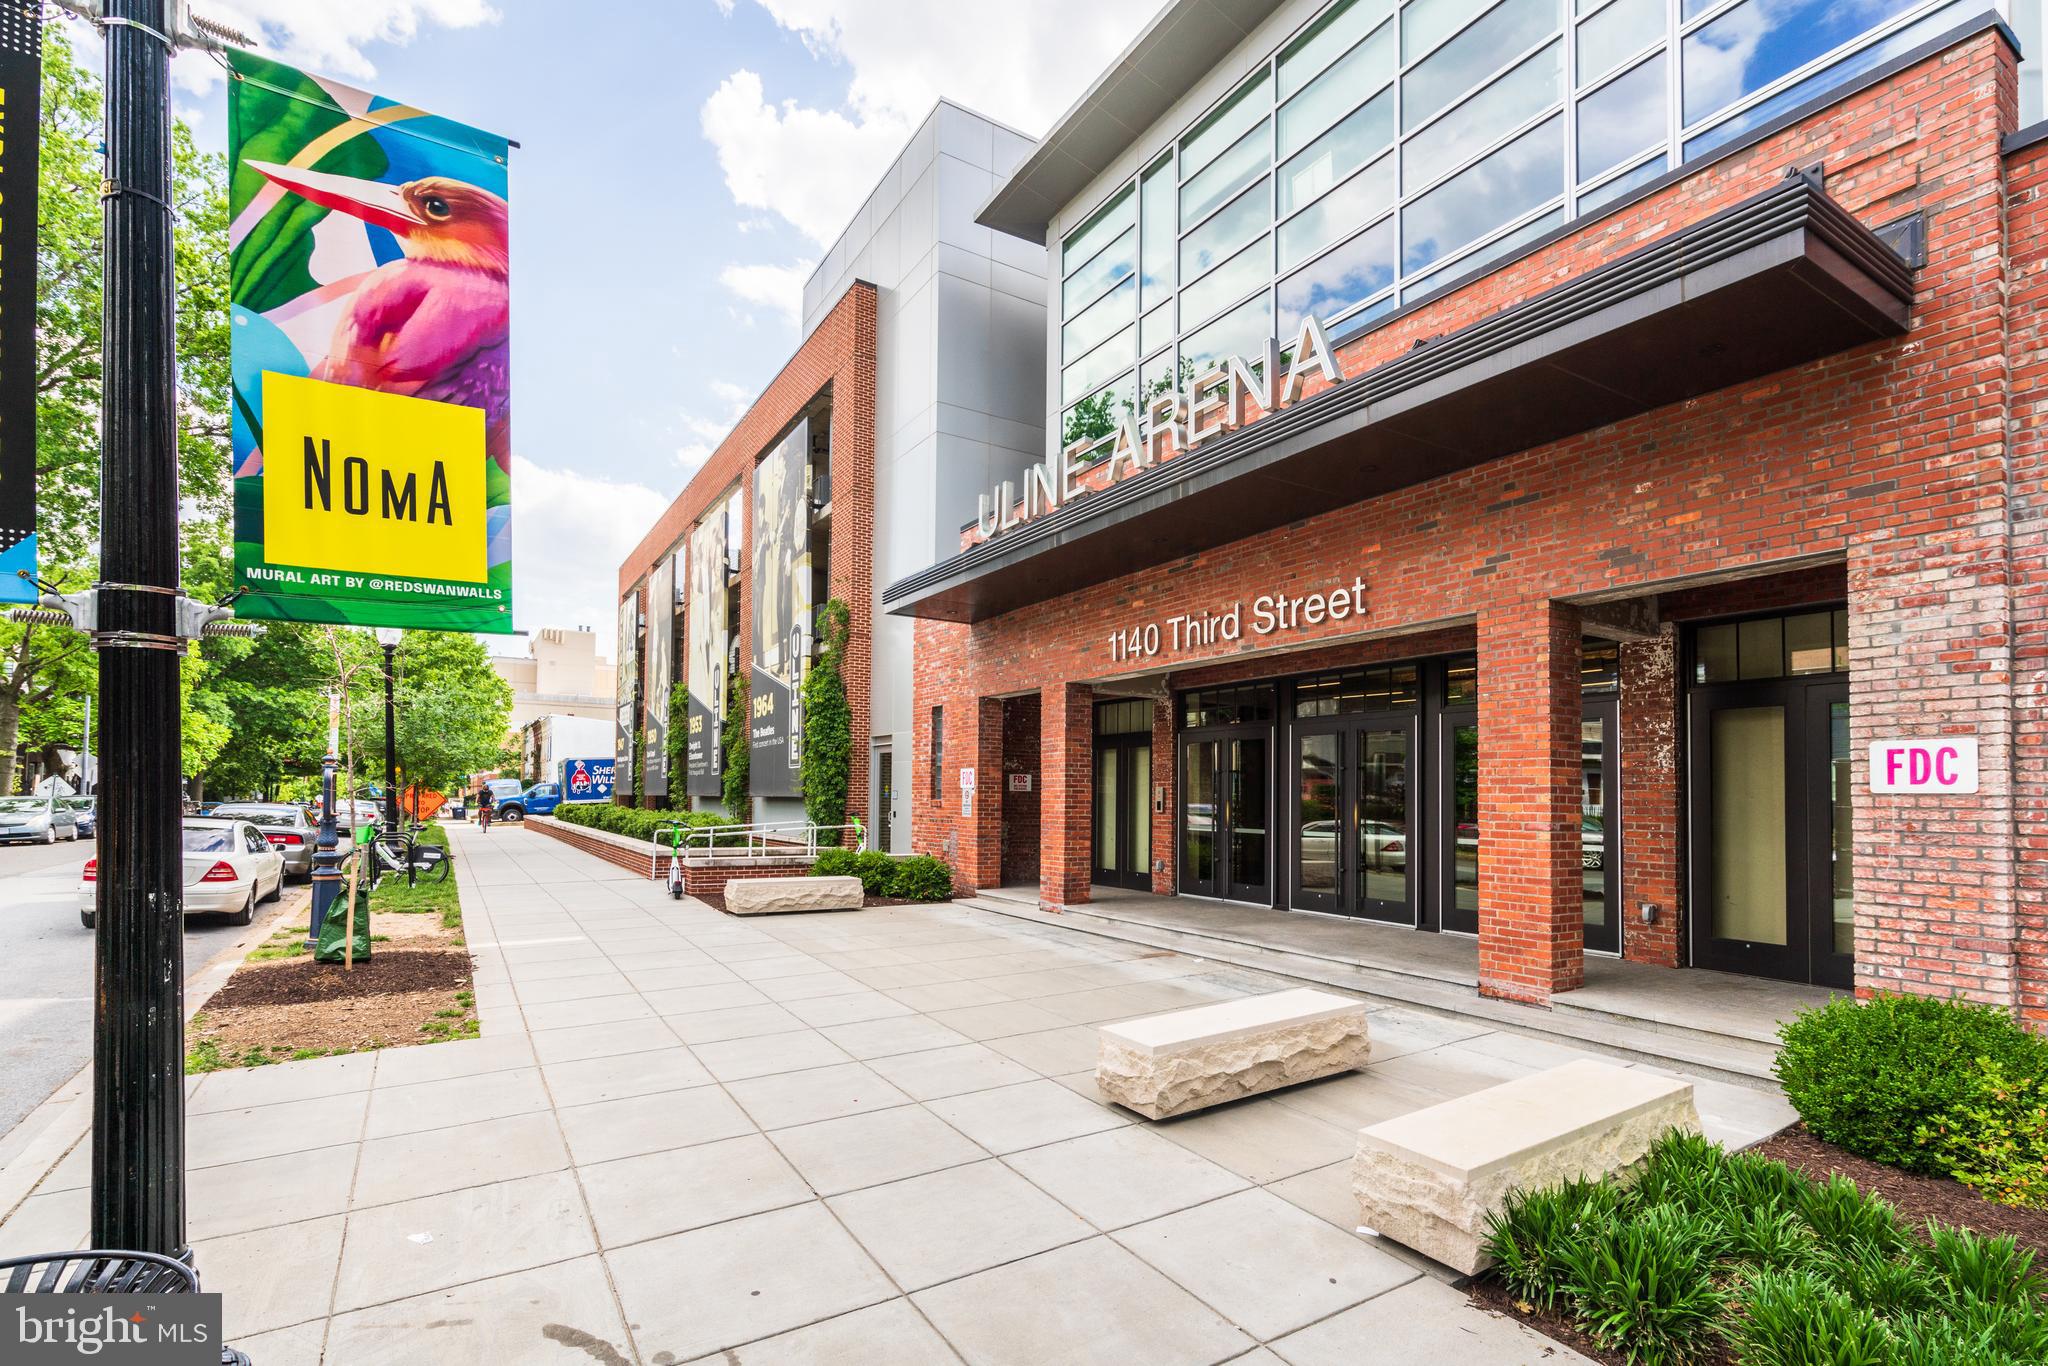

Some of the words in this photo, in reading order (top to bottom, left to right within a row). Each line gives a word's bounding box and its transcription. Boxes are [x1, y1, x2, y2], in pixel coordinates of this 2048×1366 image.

[976, 435, 1095, 538] ULINE
[1106, 314, 1346, 482] ARENA
[246, 567, 305, 584] MURAL
[310, 575, 341, 587] ART
[345, 577, 364, 588] BY
[369, 578, 502, 600] @REDSWANWALLS
[1108, 623, 1161, 662] 1140
[1167, 602, 1241, 651] Third
[1252, 576, 1367, 635] Street
[753, 693, 774, 719] 1964
[791, 633, 799, 760] ULINE
[752, 728, 760, 739] The
[760, 725, 775, 737] Beatles
[1013, 775, 1028, 784] FDC
[1886, 746, 1960, 786] FDC
